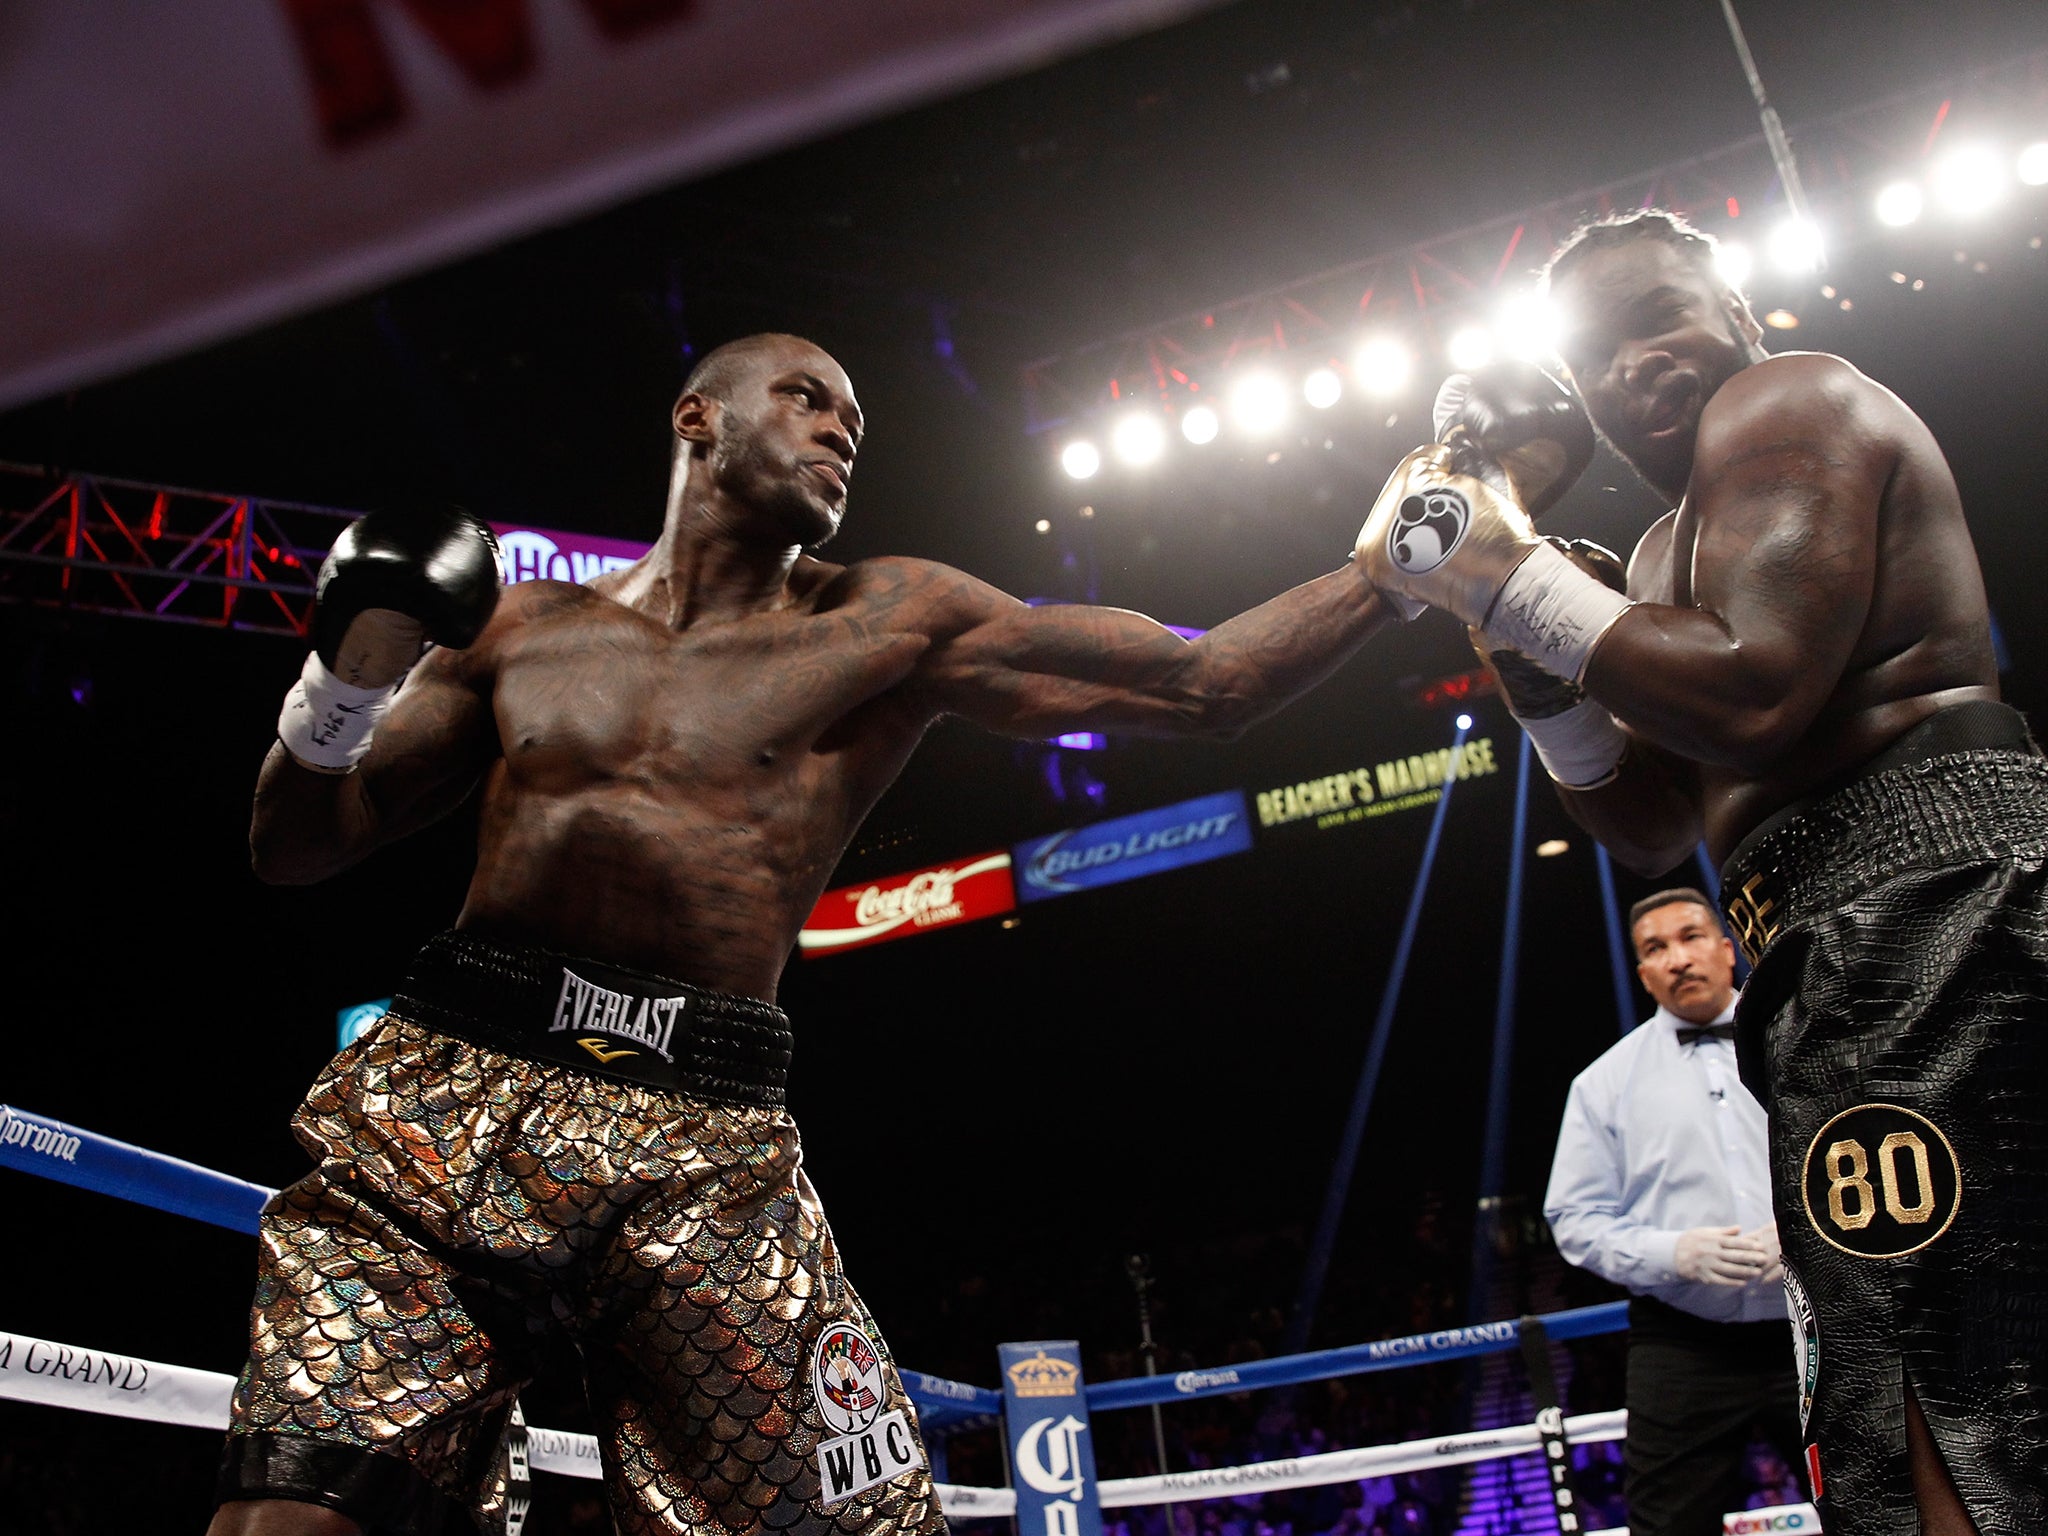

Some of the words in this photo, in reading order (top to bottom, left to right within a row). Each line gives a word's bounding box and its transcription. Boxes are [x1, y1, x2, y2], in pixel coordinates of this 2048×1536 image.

[1375, 737, 1498, 799] MADHOUSE
[1125, 812, 1238, 857] LIGHT
[548, 967, 686, 1064] EVERLAST
[1825, 1131, 1936, 1231] 80
[25, 1341, 147, 1391] GRAND
[1369, 1336, 1427, 1361] MGM
[1430, 1320, 1514, 1350] GRAND
[825, 1421, 911, 1496] WBC
